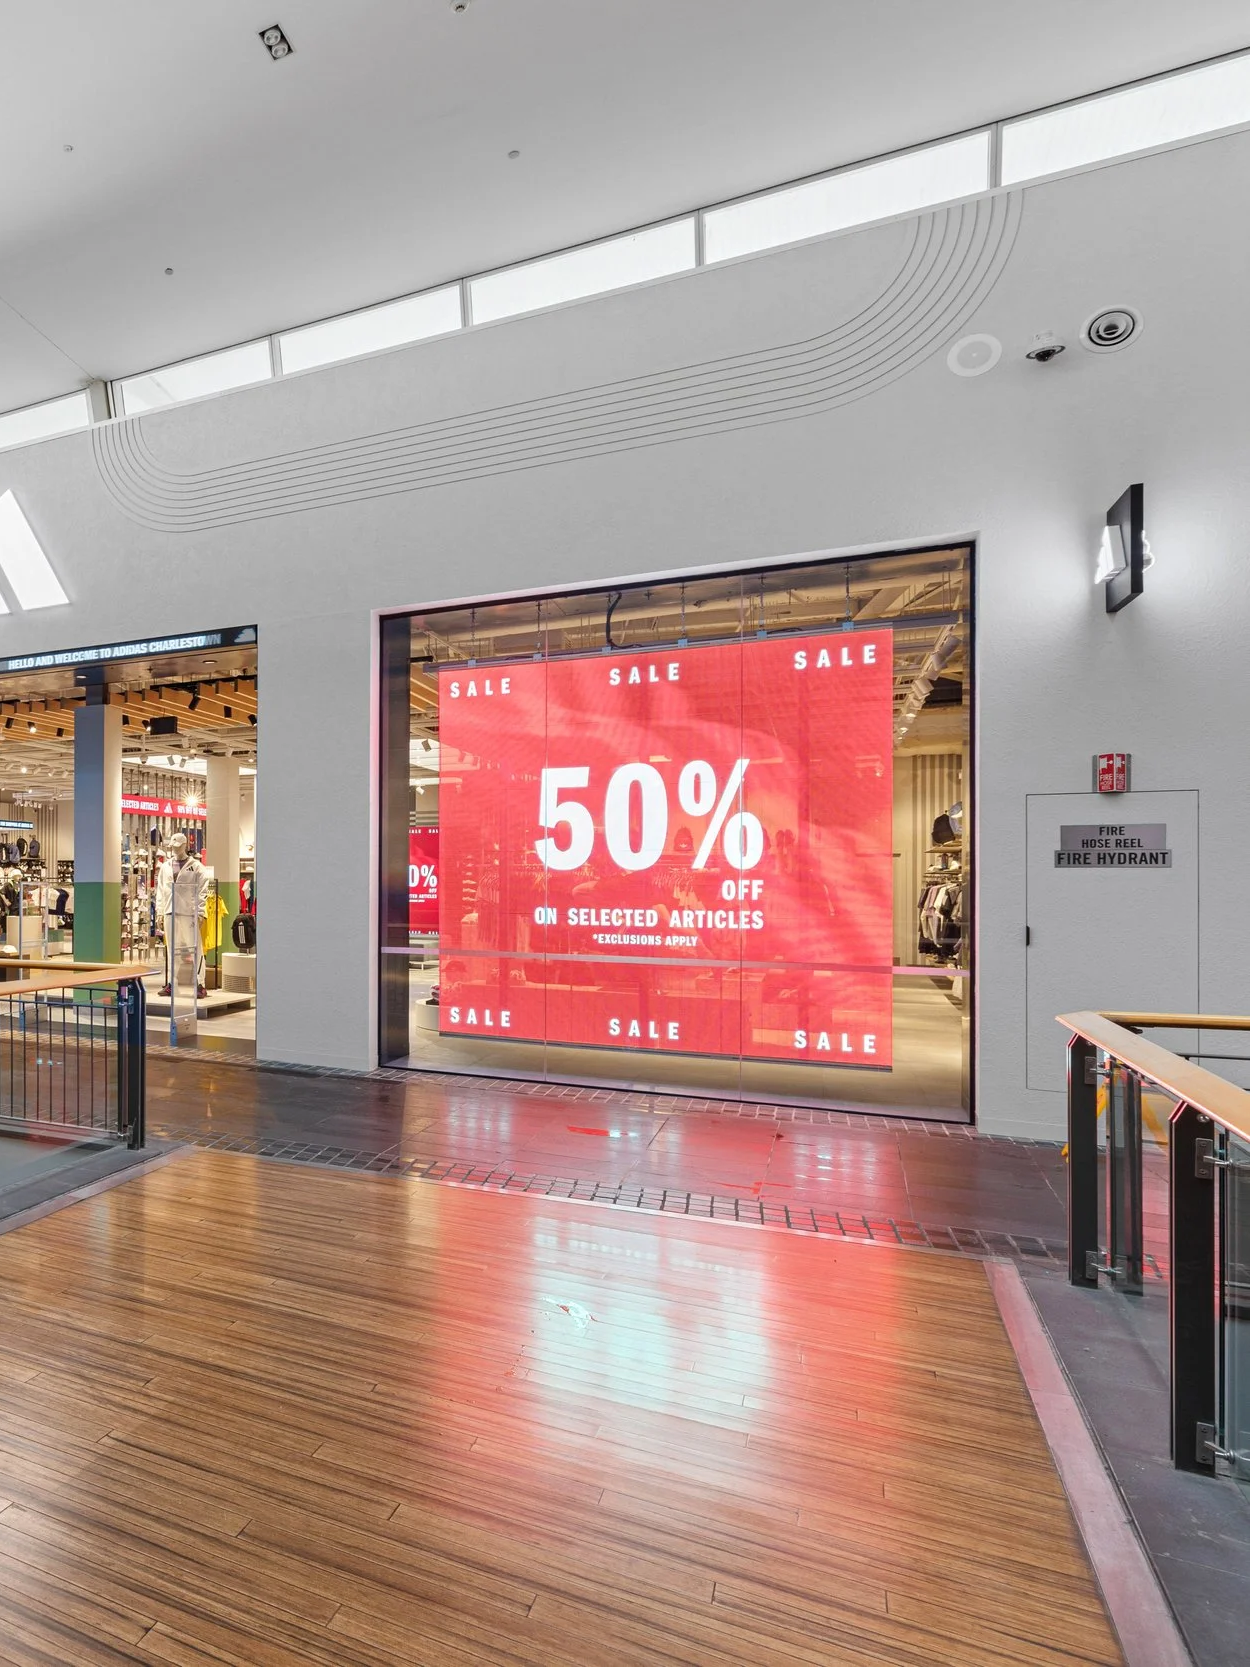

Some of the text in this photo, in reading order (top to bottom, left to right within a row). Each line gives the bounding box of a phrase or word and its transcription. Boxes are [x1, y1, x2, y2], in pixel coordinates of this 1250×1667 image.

[8, 658, 34, 670] HELLO
[35, 655, 54, 667] AND
[99, 648, 111, 659] TO
[113, 643, 147, 657] ADIDAS
[149, 634, 221, 653] CHARLESTOWN
[794, 645, 876, 670] SALE
[609, 663, 679, 686] SALE
[450, 678, 511, 698] SALE
[535, 758, 764, 871] 50%
[1099, 826, 1125, 836] FIRE
[1082, 838, 1143, 848] HOSE REEL
[1057, 852, 1168, 865] FIRE HYDRANT
[409, 864, 438, 888] 0%
[721, 879, 764, 901] OFF
[534, 906, 764, 930] ON SELECTED ARTICLES
[665, 936, 698, 947] APPLY
[450, 1006, 511, 1027] SALE
[608, 1018, 679, 1039] SALE
[794, 1030, 876, 1053] SALE
